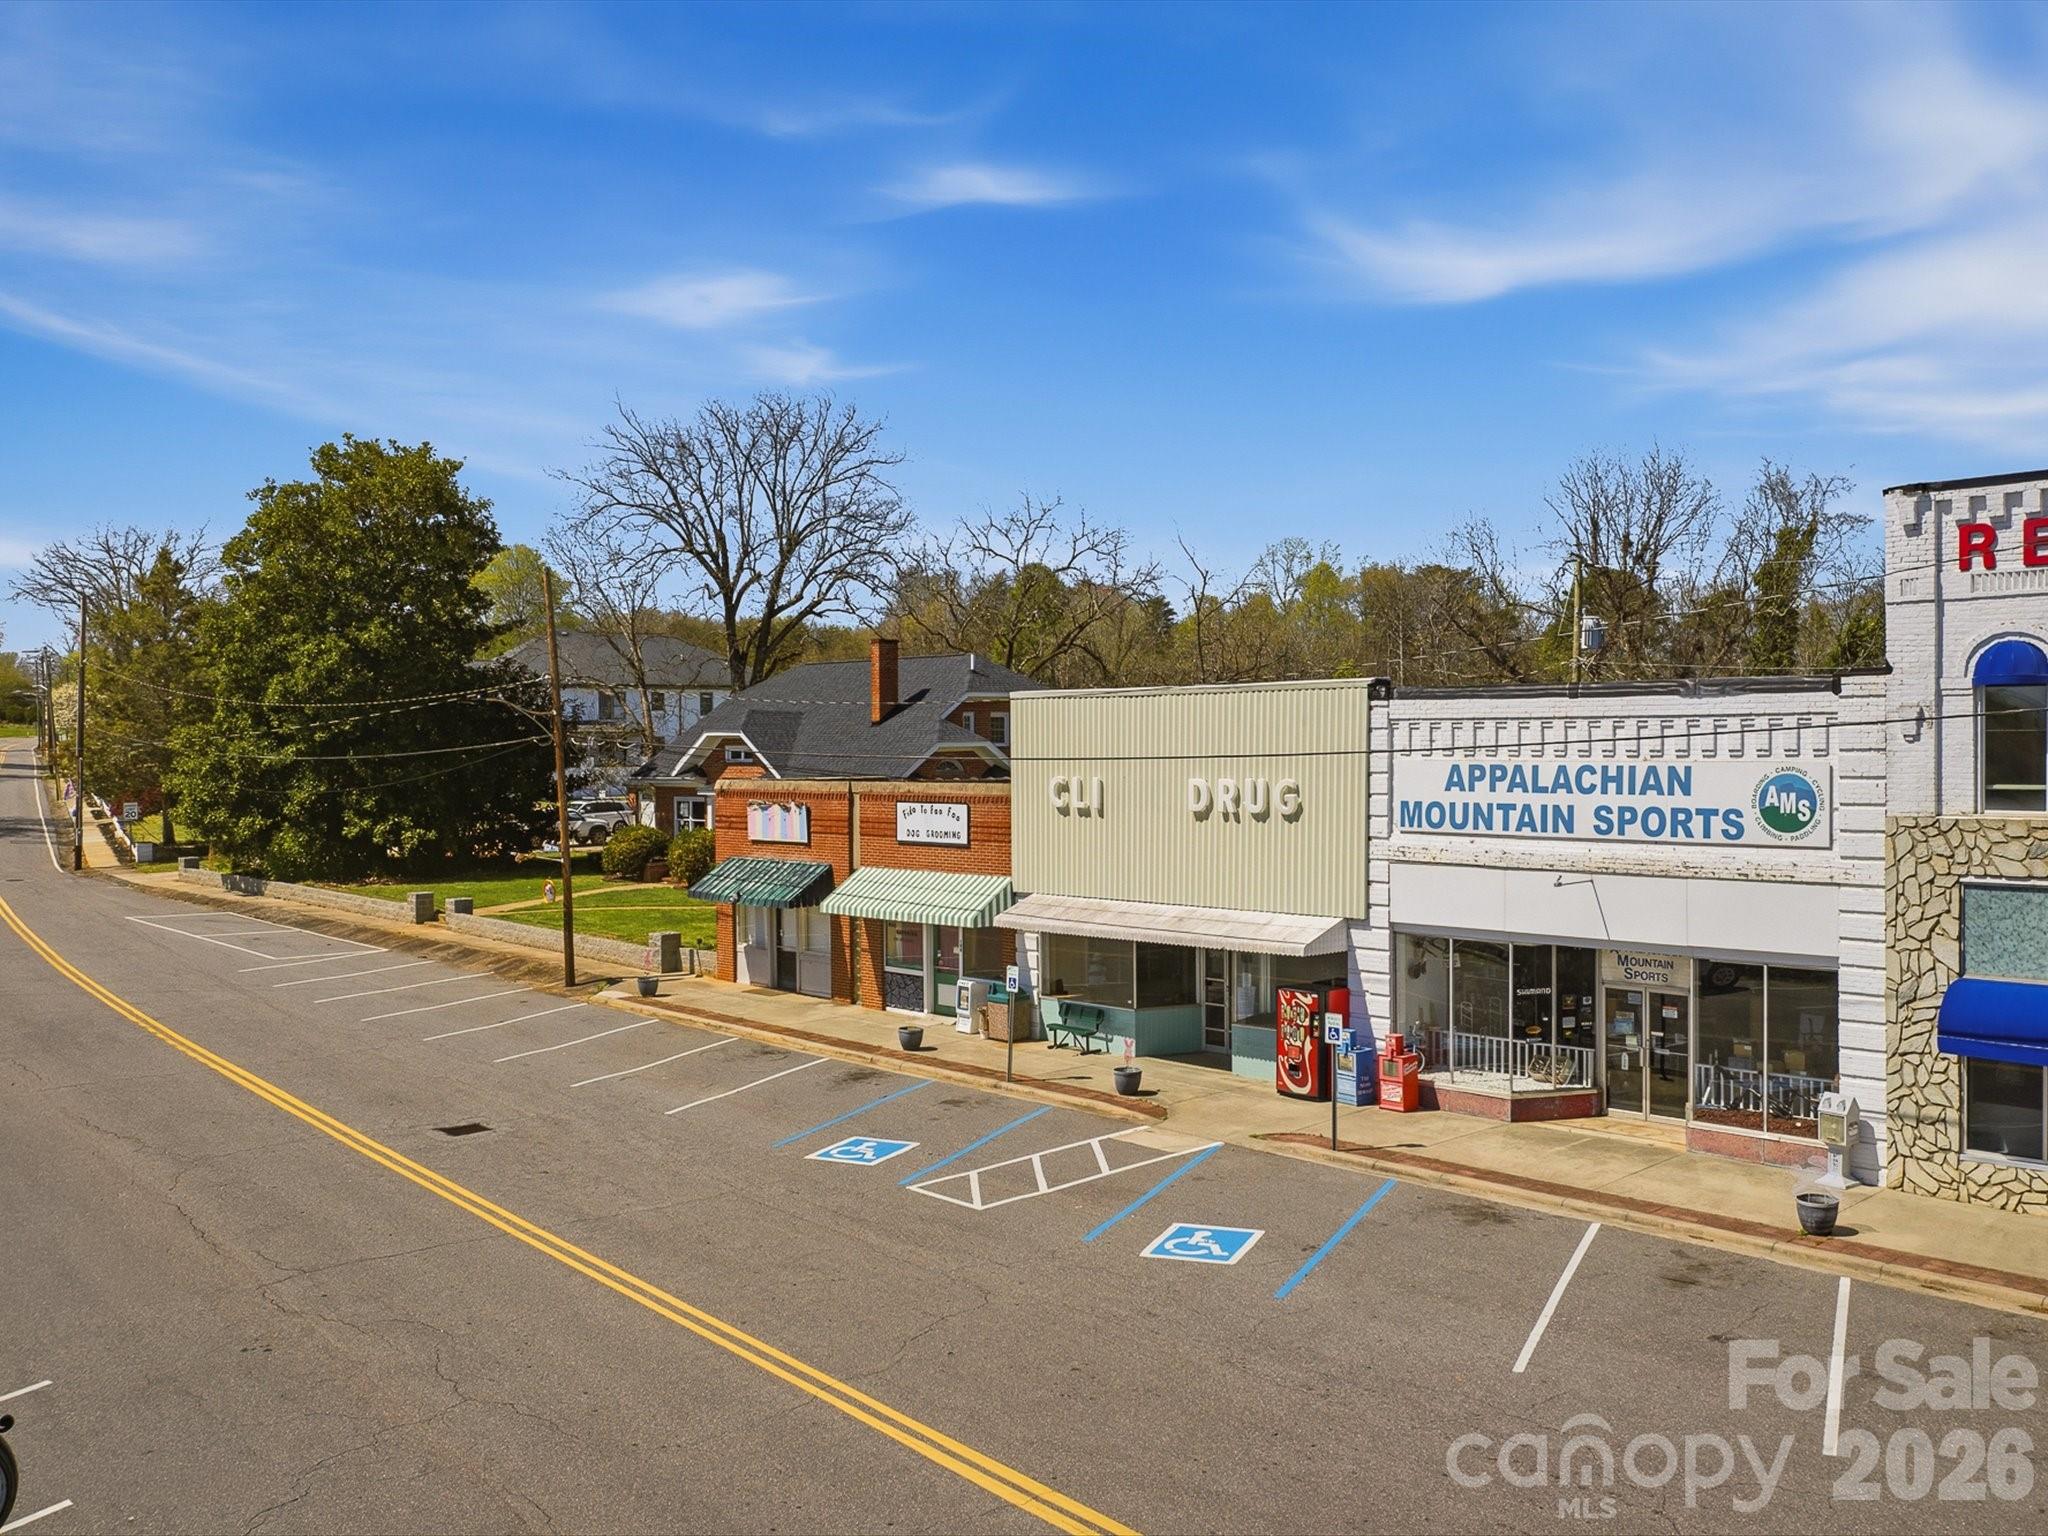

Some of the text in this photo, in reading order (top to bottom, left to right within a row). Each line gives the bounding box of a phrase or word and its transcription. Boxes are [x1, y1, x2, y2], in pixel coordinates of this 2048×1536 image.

[1187, 777, 1302, 816] DRUG
[1444, 763, 1693, 797] APPALACHIAN
[1775, 766, 1808, 777] CAMPING
[1811, 779, 1825, 811] CYCLING
[1400, 800, 1745, 841] MOUNTAIN SPORTS
[1765, 785, 1811, 822] AMS
[906, 828, 961, 840] DOG GROOMING
[1755, 817, 1783, 841] CLIMBING
